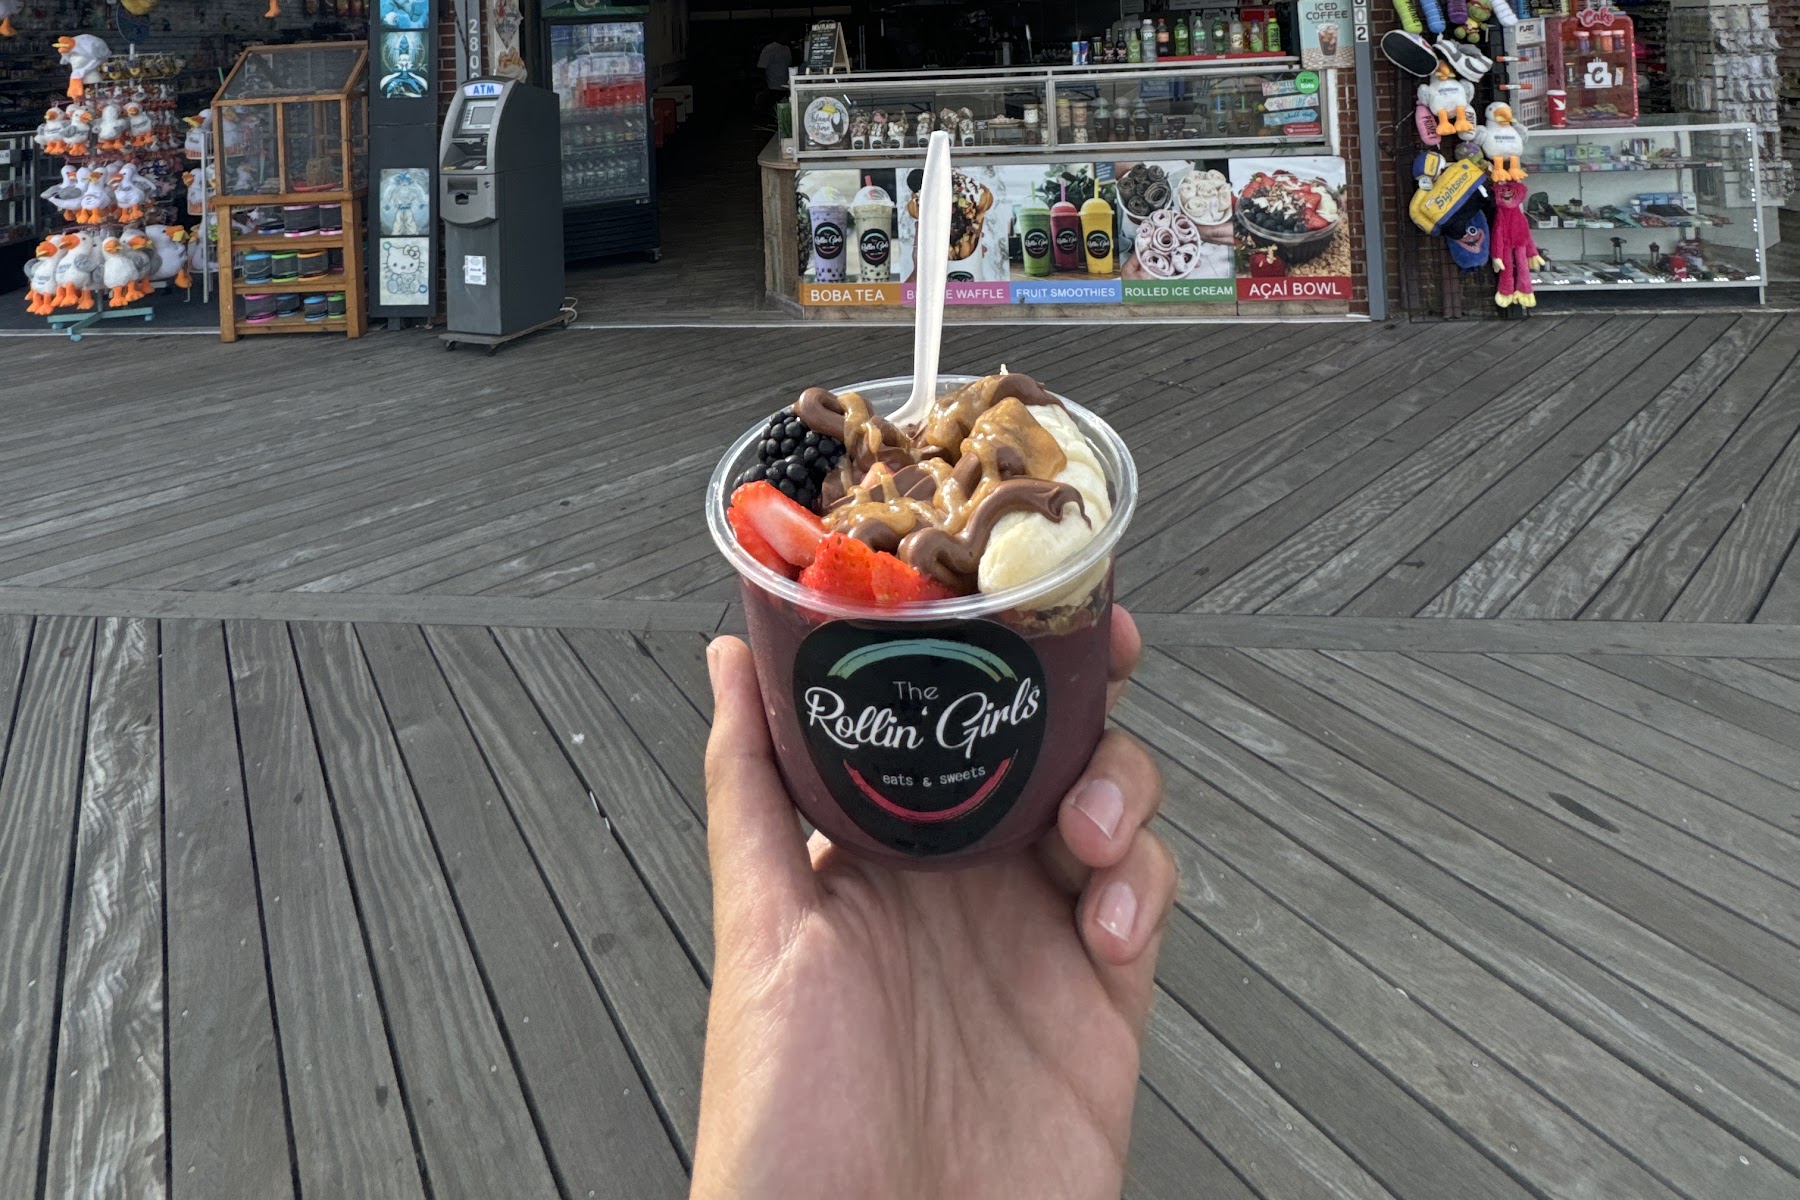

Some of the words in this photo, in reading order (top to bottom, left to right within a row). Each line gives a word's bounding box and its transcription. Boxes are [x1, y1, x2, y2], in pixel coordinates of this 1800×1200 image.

[1314, 2, 1338, 12] ICED
[1305, 10, 1349, 21] COFFEE
[473, 84, 495, 95] ATM
[1435, 171, 1469, 210] Sightseer
[810, 288, 852, 303] BOBA
[855, 288, 886, 302] TEA
[955, 287, 1005, 301] WAFFLE
[1015, 287, 1049, 300] FRUIT
[1049, 286, 1117, 299] SMOOTHIES
[1124, 286, 1170, 298] ROLLED
[1171, 286, 1191, 298] ICE
[1193, 285, 1235, 297] CREAM
[1248, 280, 1289, 300] AÇAÍ
[1292, 281, 1343, 297] BOWL
[892, 680, 940, 701] The
[934, 676, 1042, 760] Girls
[882, 772, 914, 787] eats
[921, 776, 933, 788] &
[939, 765, 987, 785] sweets
